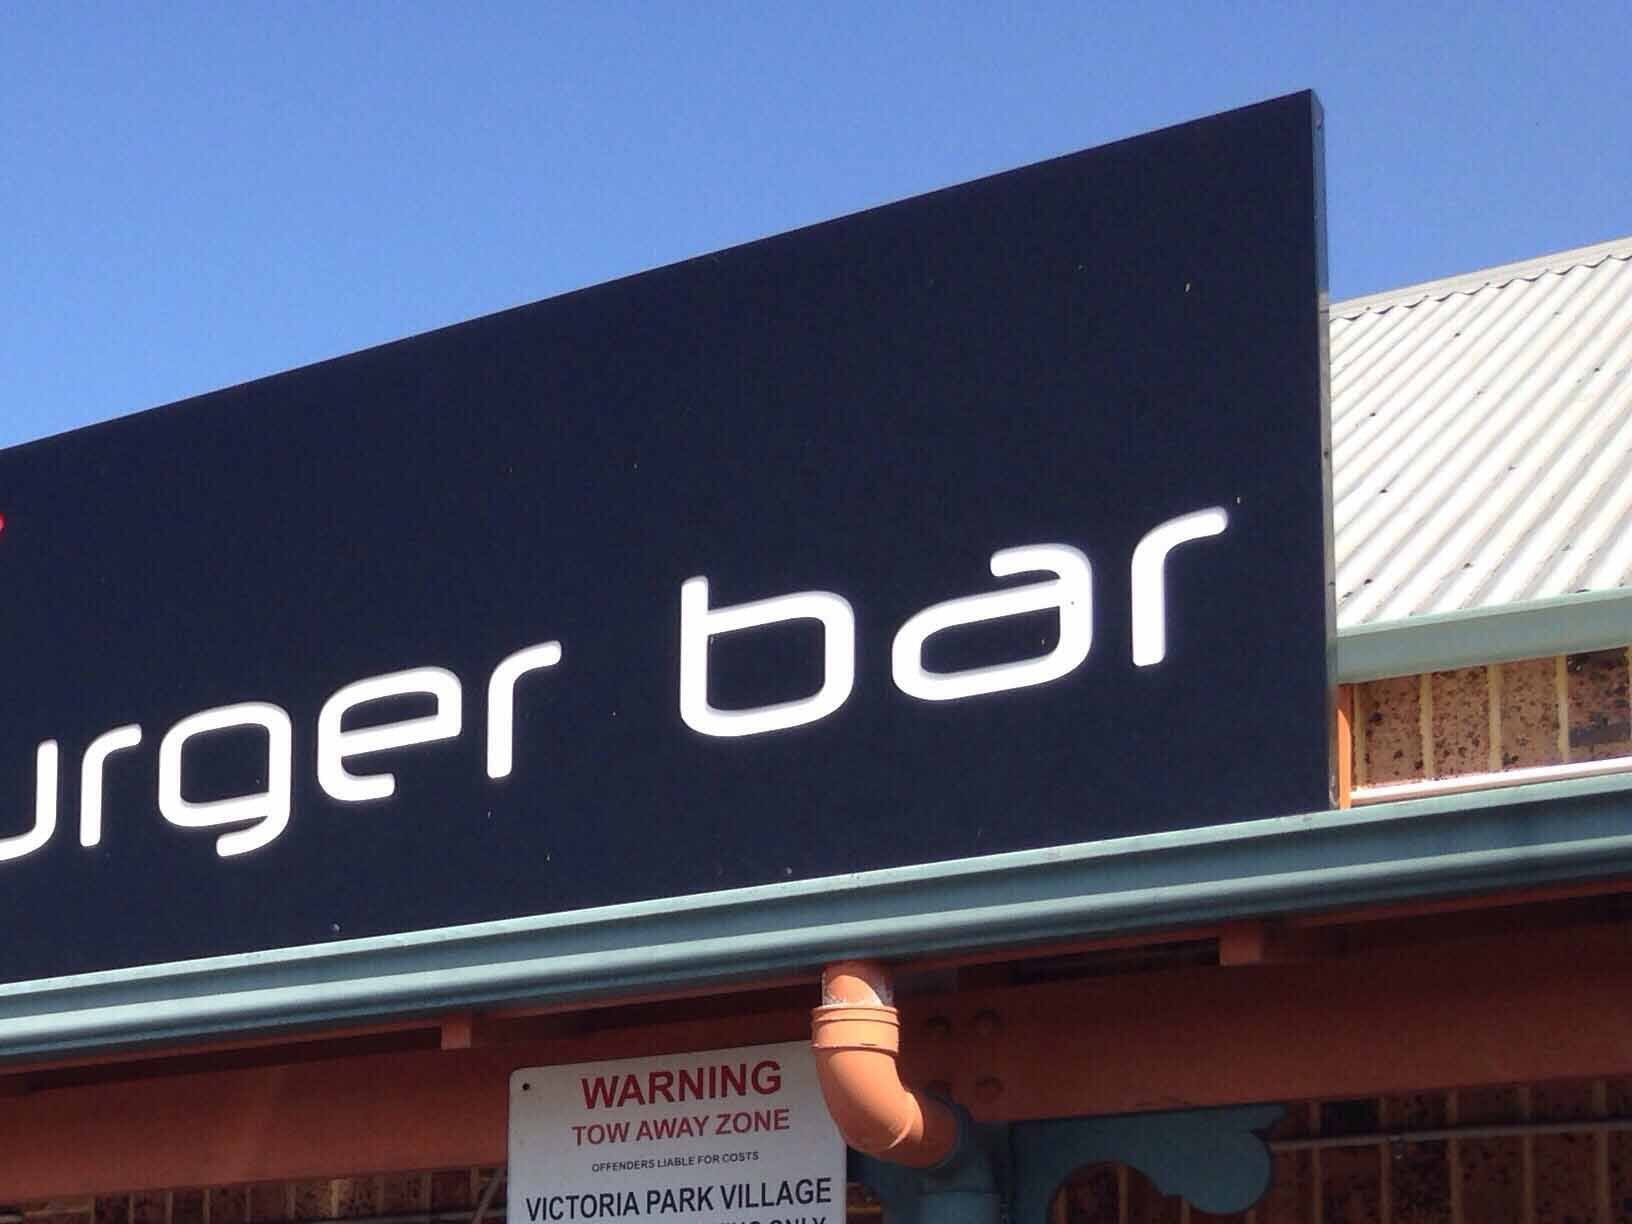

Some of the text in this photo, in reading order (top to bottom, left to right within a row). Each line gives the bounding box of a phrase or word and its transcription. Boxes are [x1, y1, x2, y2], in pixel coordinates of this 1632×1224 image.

[679, 505, 1229, 738] bar
[581, 1060, 782, 1110] WARNING
[572, 1108, 791, 1147] TOW AWAY ZONE
[591, 1151, 760, 1174] OFFENDERS LIABLE FOR COSTS
[525, 1177, 833, 1222] VICTORIA PARK VILLAGE
